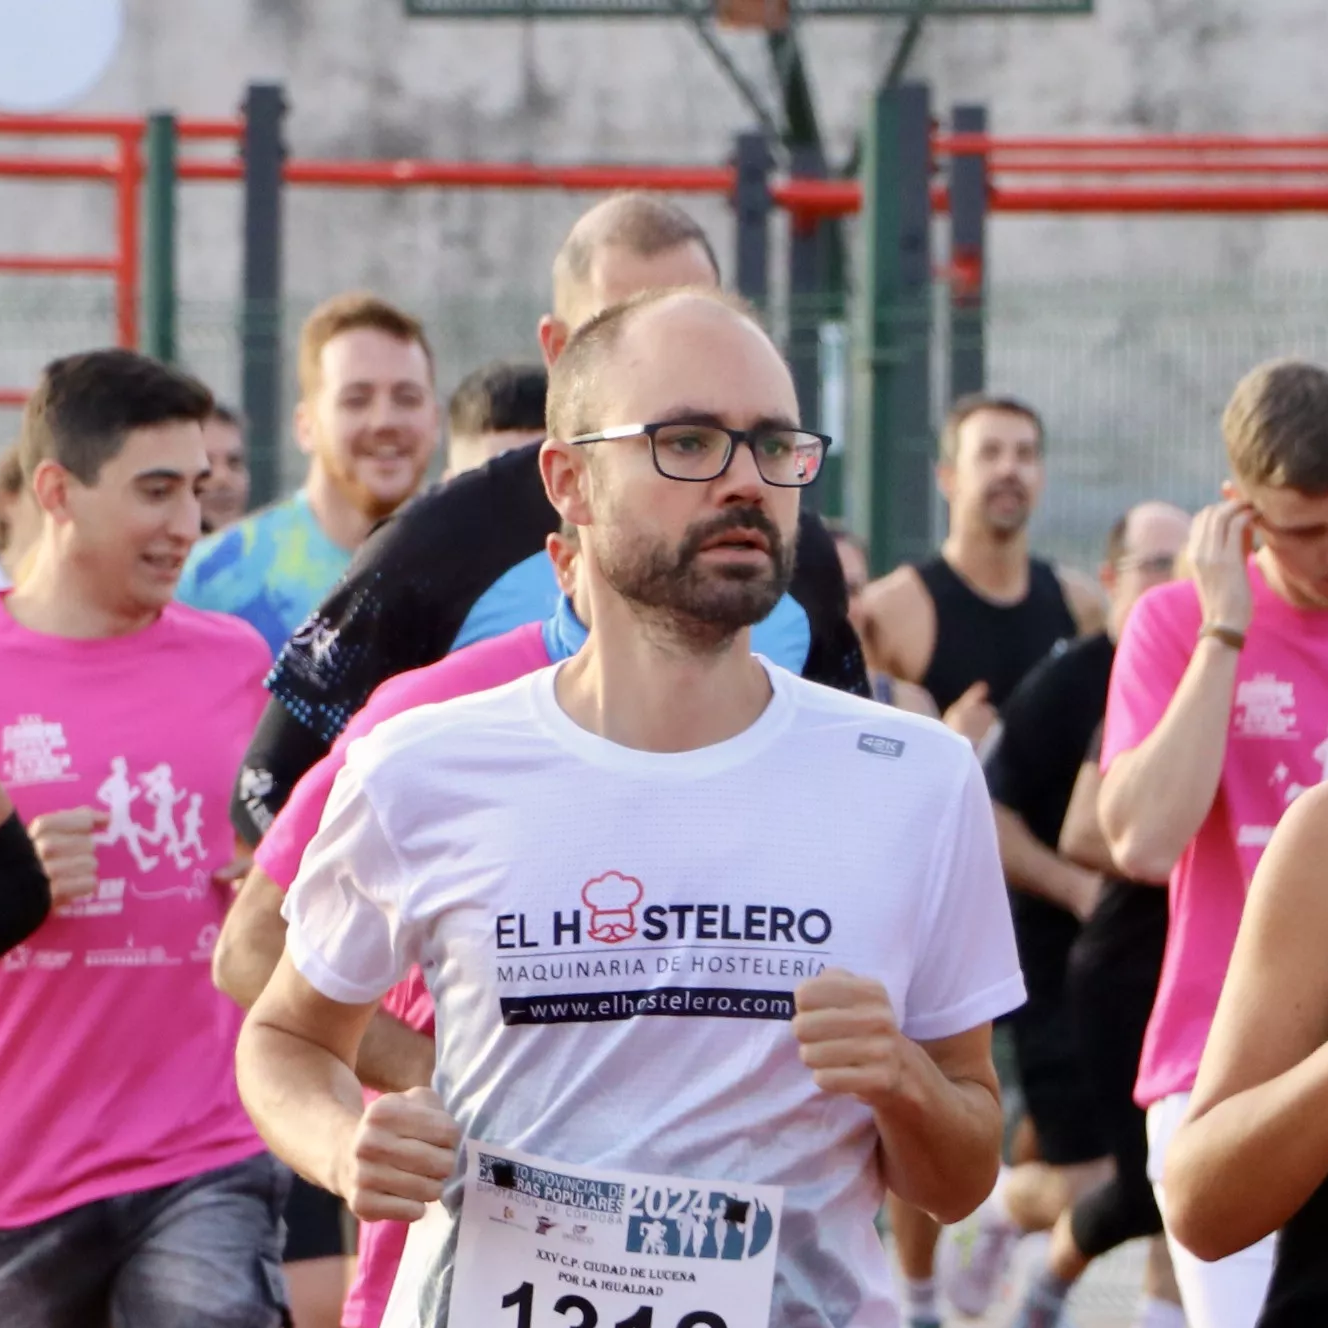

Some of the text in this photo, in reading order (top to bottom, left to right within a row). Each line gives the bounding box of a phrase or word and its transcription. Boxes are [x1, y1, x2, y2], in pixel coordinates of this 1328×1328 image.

[496, 913, 538, 949] EL
[497, 957, 646, 983] MAQUINARIA
[657, 957, 681, 974] DE
[529, 990, 791, 1019] www.elhostelero.com
[531, 1169, 604, 1197] PROVINCIAL
[608, 1183, 626, 1198] DE
[543, 1187, 625, 1213] POPULARES
[545, 1203, 558, 1215] DE
[626, 1184, 711, 1220] 2024
[536, 1248, 697, 1282] XXV C.P. CIUDAD DE LUCENA
[558, 1272, 664, 1297] POR LA IGUALDAD
